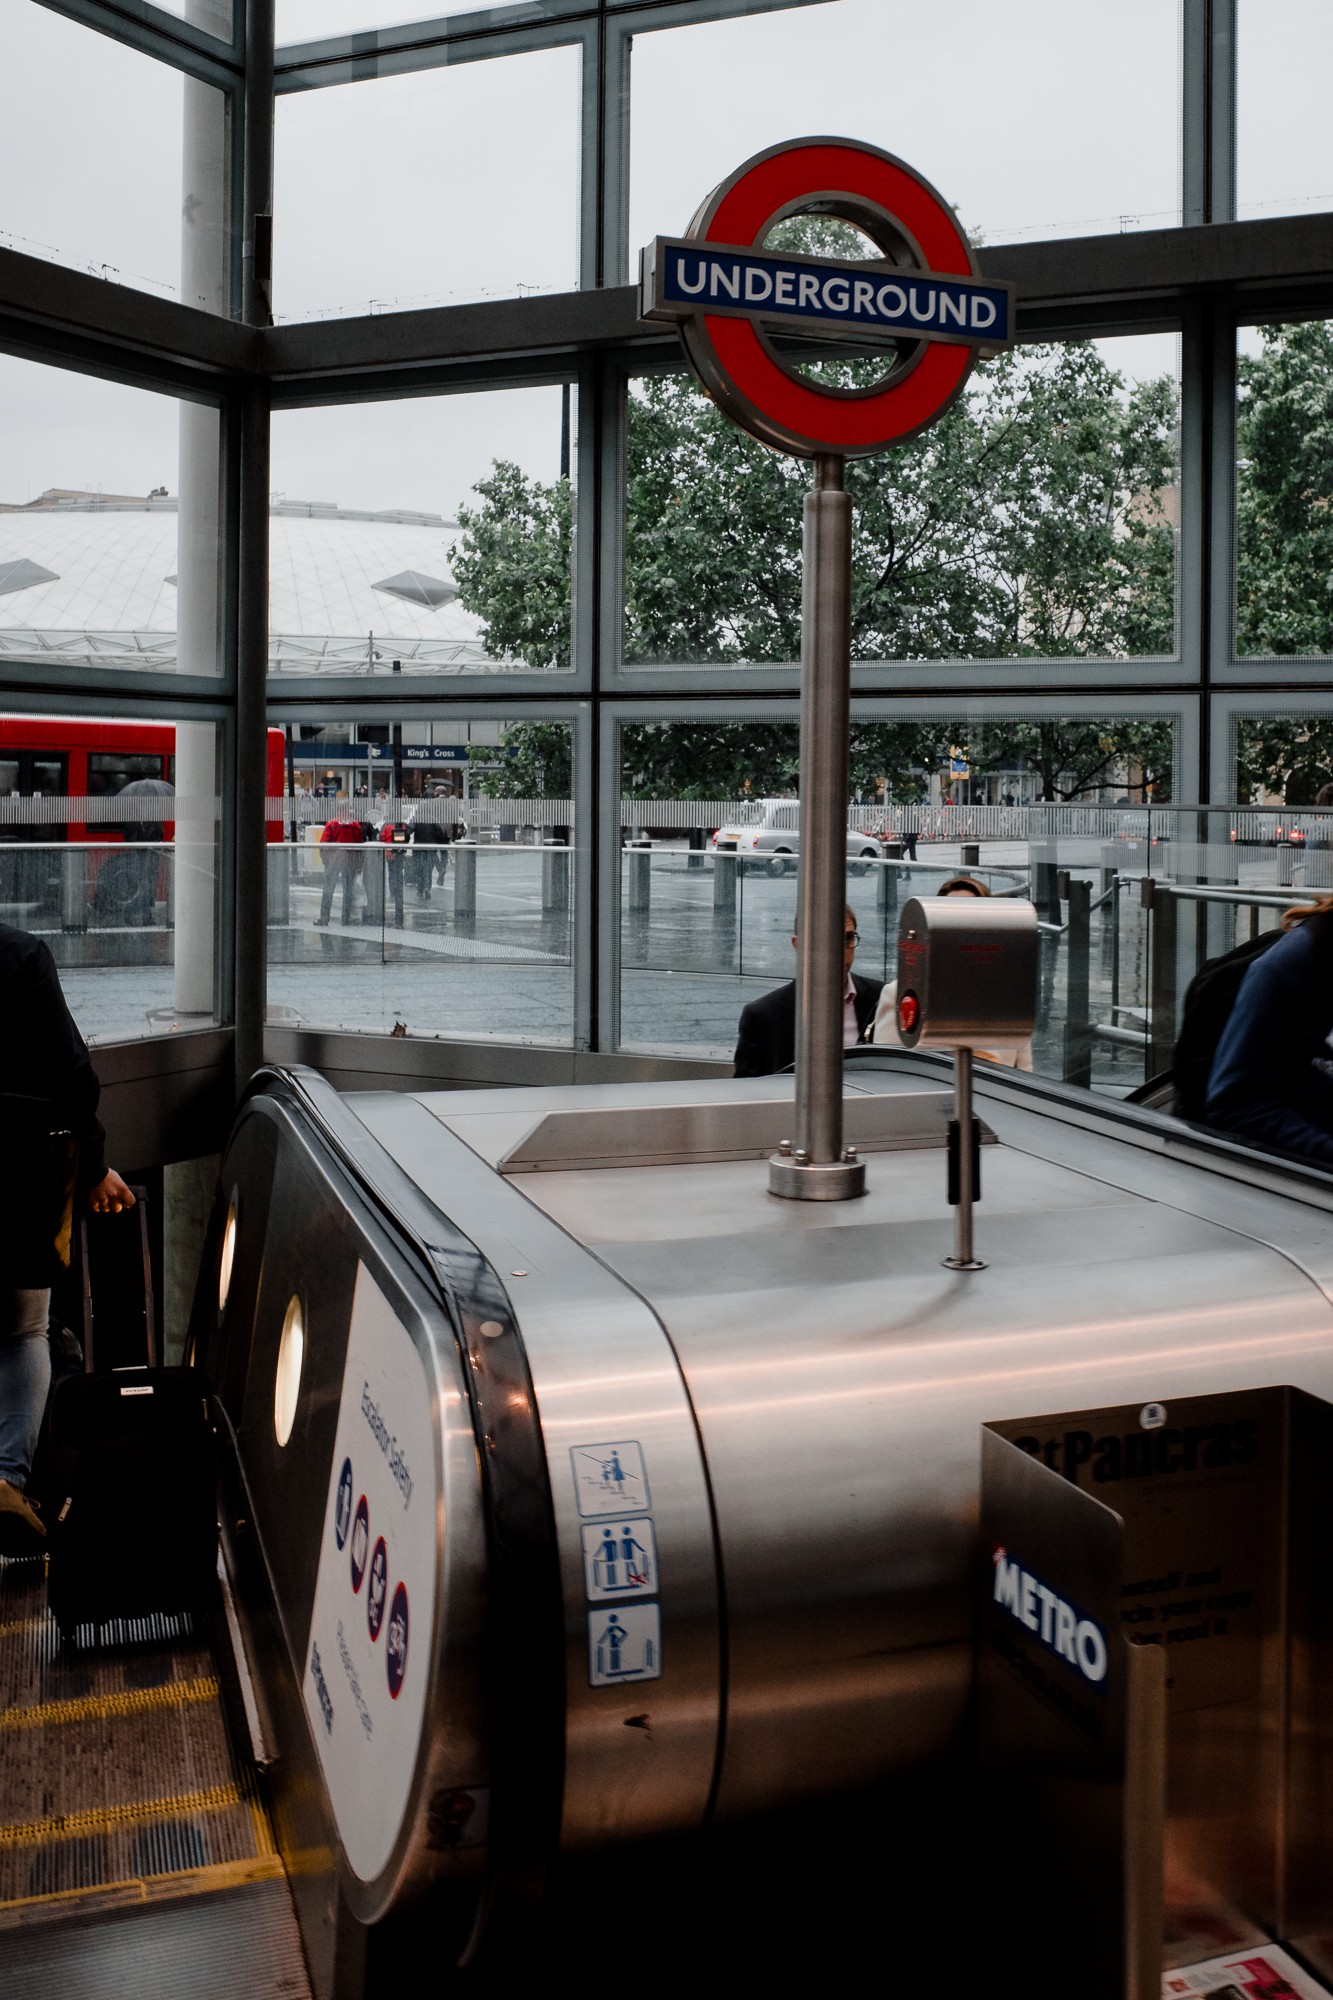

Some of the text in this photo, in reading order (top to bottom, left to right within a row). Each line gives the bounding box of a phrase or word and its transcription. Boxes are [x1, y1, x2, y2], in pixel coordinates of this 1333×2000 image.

[676, 258, 997, 328] UNDERGROUND
[407, 749, 455, 759] King's Cross
[1063, 1419, 1259, 1485] Pancras
[993, 1553, 1107, 1682] METRO
